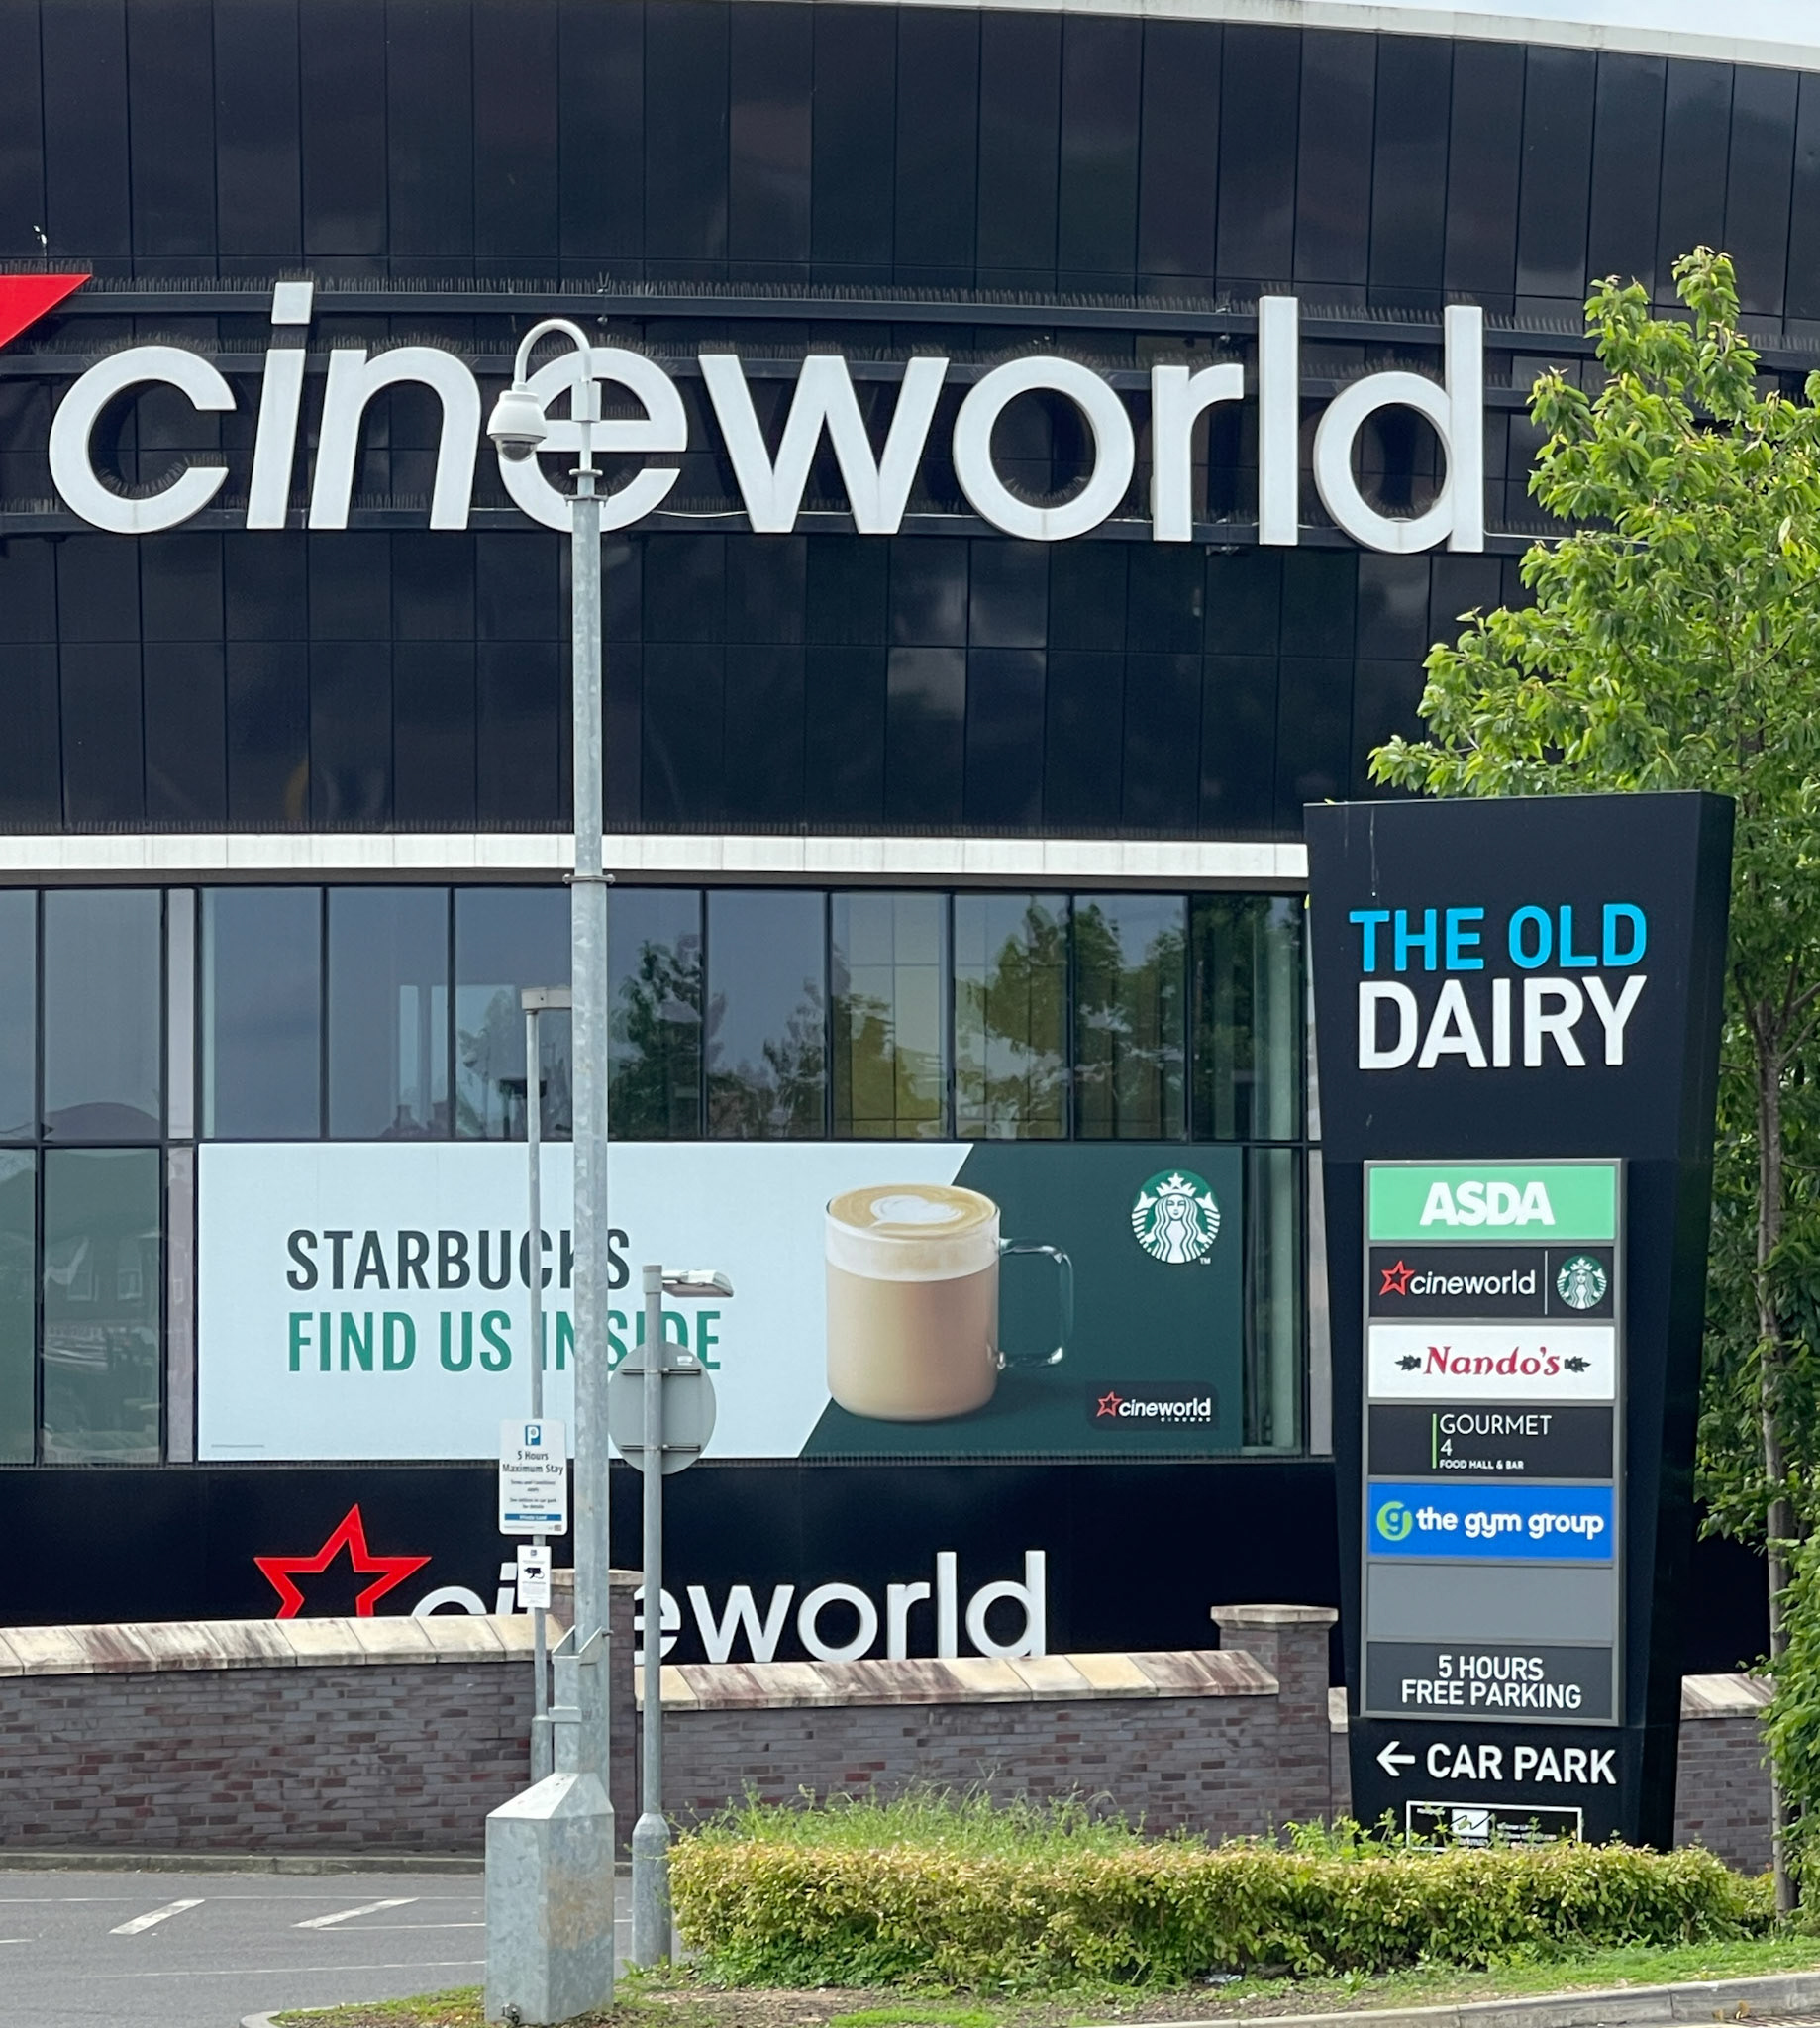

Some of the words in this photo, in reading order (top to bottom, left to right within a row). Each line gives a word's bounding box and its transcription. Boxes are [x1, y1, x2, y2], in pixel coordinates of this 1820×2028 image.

[49, 281, 1483, 554] cineworld
[1349, 907, 1484, 972] THE
[1508, 903, 1647, 969] OLD
[1358, 975, 1647, 1069] DAIRY
[1419, 1181, 1556, 1227] ASDA
[1409, 1269, 1535, 1295] cineworld
[288, 1311, 416, 1372] FIND
[440, 1310, 512, 1372] US
[1423, 1346, 1561, 1376] Nando's
[1118, 1397, 1211, 1417] cineworld
[1439, 1414, 1552, 1436] GOURMET
[517, 1450, 523, 1461] 5
[525, 1450, 549, 1461] Hours
[1440, 1438, 1453, 1457] 4
[502, 1464, 544, 1473] Maximum
[546, 1464, 564, 1475] Stay
[1439, 1459, 1467, 1470] FOOD
[1468, 1460, 1494, 1470] HALL
[1496, 1459, 1504, 1470] &
[1505, 1460, 1524, 1470] BAR
[1416, 1506, 1458, 1531] the
[1465, 1512, 1522, 1538] gym
[1528, 1513, 1604, 1540] group
[1438, 1654, 1453, 1678] 5
[1460, 1655, 1544, 1681] HOURS
[1401, 1679, 1464, 1705] FREE
[1470, 1682, 1582, 1709] PARKING
[1427, 1743, 1503, 1780] CAR
[1514, 1746, 1617, 1784] PARK
